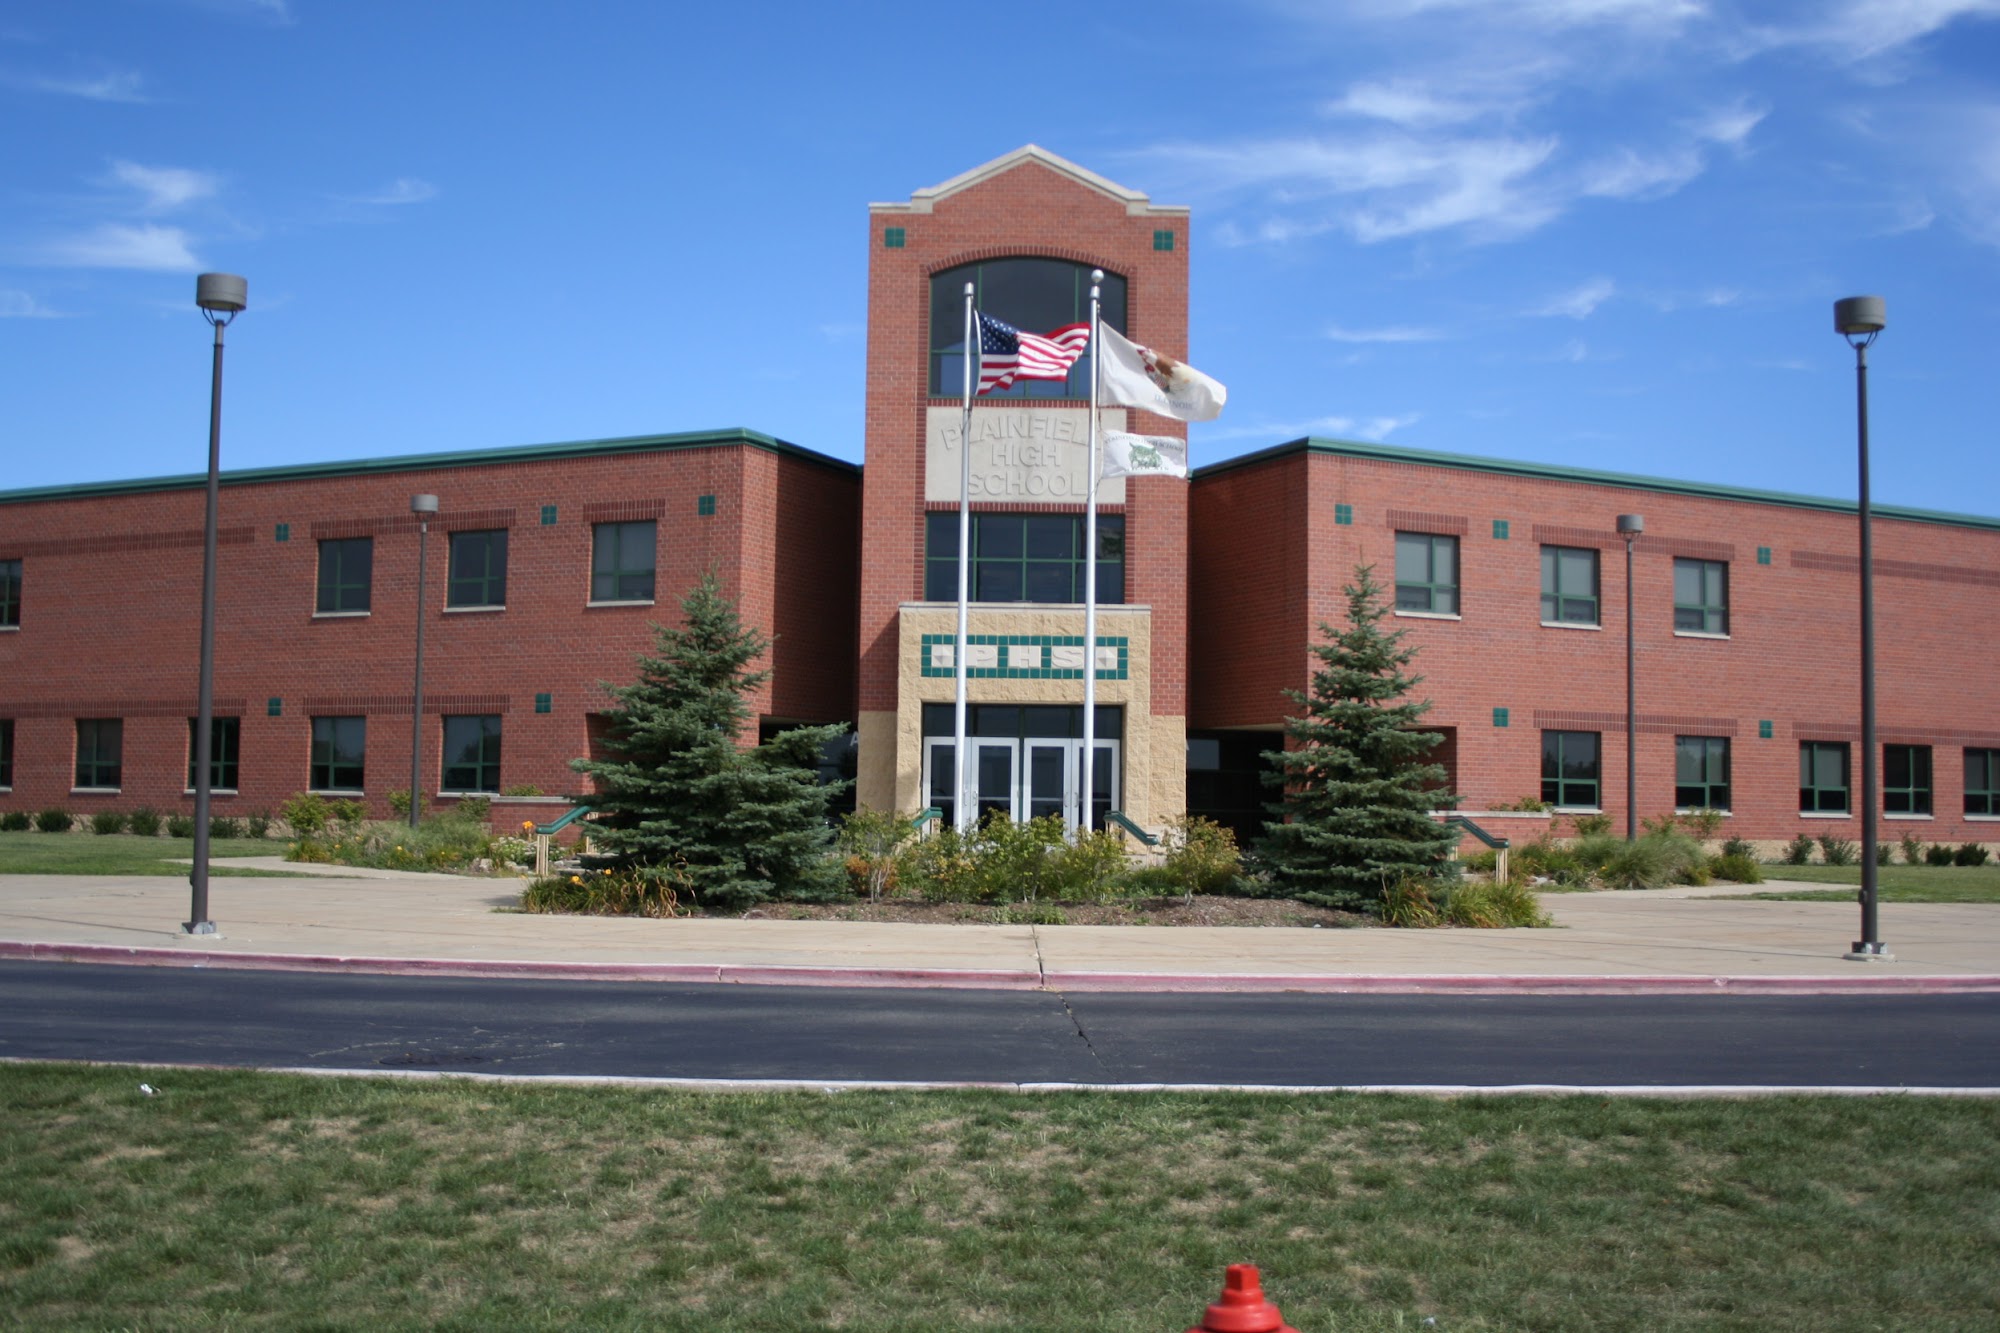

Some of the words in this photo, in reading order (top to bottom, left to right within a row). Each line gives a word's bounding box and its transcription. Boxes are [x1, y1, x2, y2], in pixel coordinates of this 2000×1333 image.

[940, 415, 1102, 451] PLAINFIEL
[991, 443, 1062, 467] HIGH
[968, 471, 1088, 496] SCHOOL
[967, 645, 1084, 669] PHS
